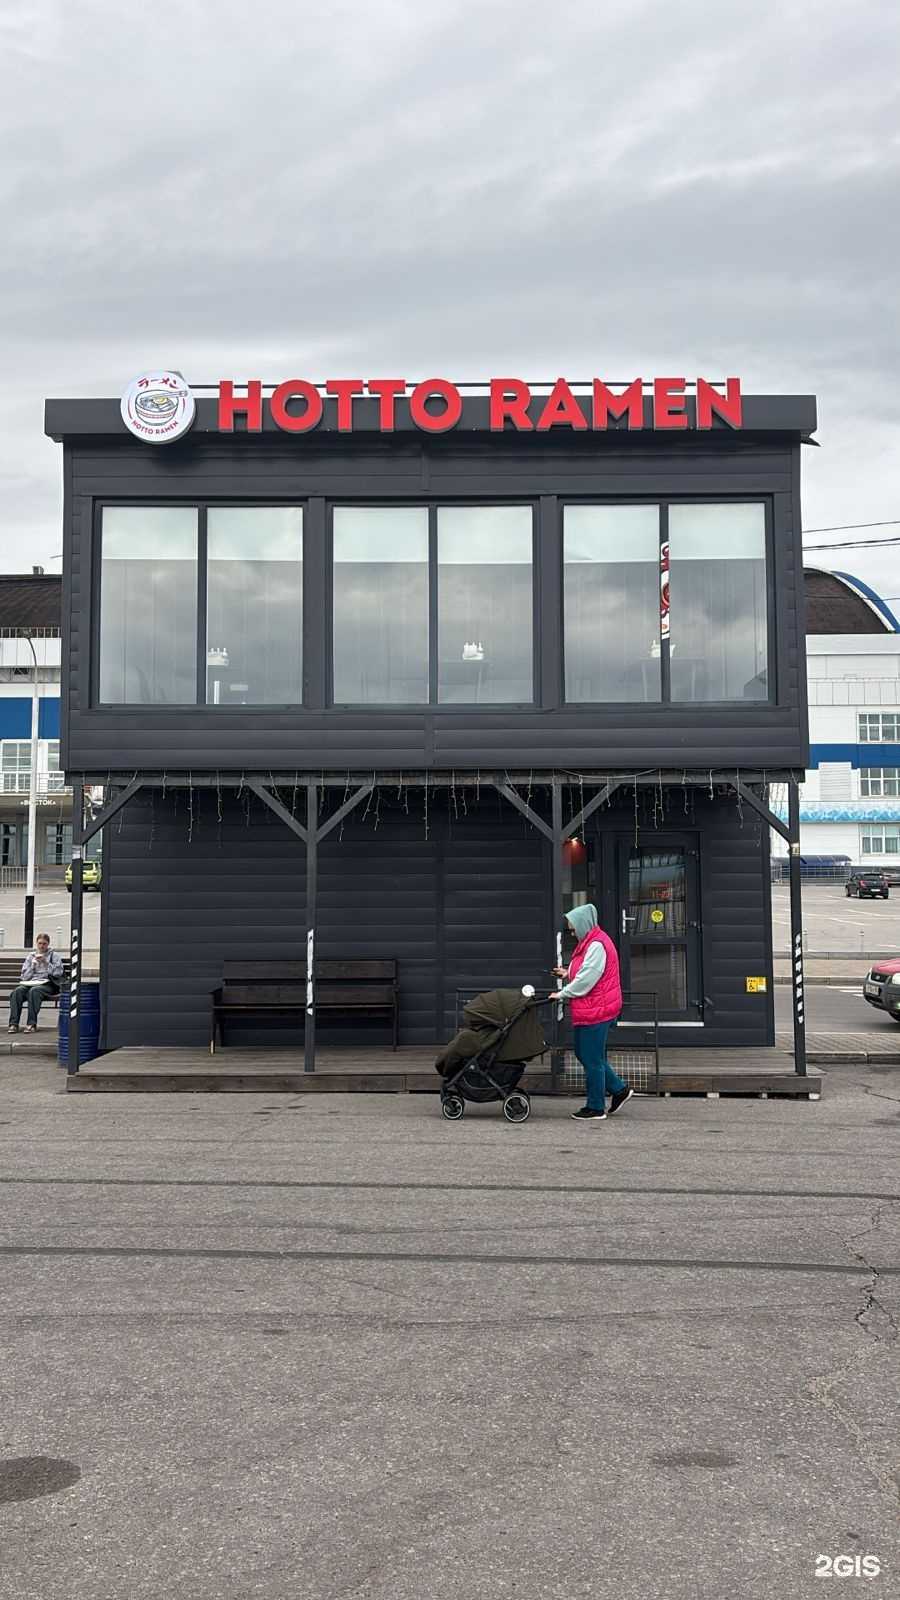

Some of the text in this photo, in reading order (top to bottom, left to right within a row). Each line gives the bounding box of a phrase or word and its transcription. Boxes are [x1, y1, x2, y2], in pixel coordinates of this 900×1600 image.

[137, 377, 179, 389] ラーメン
[218, 378, 743, 432] HOTTO RAMEN
[131, 420, 179, 434] HOTTO RAMEN
